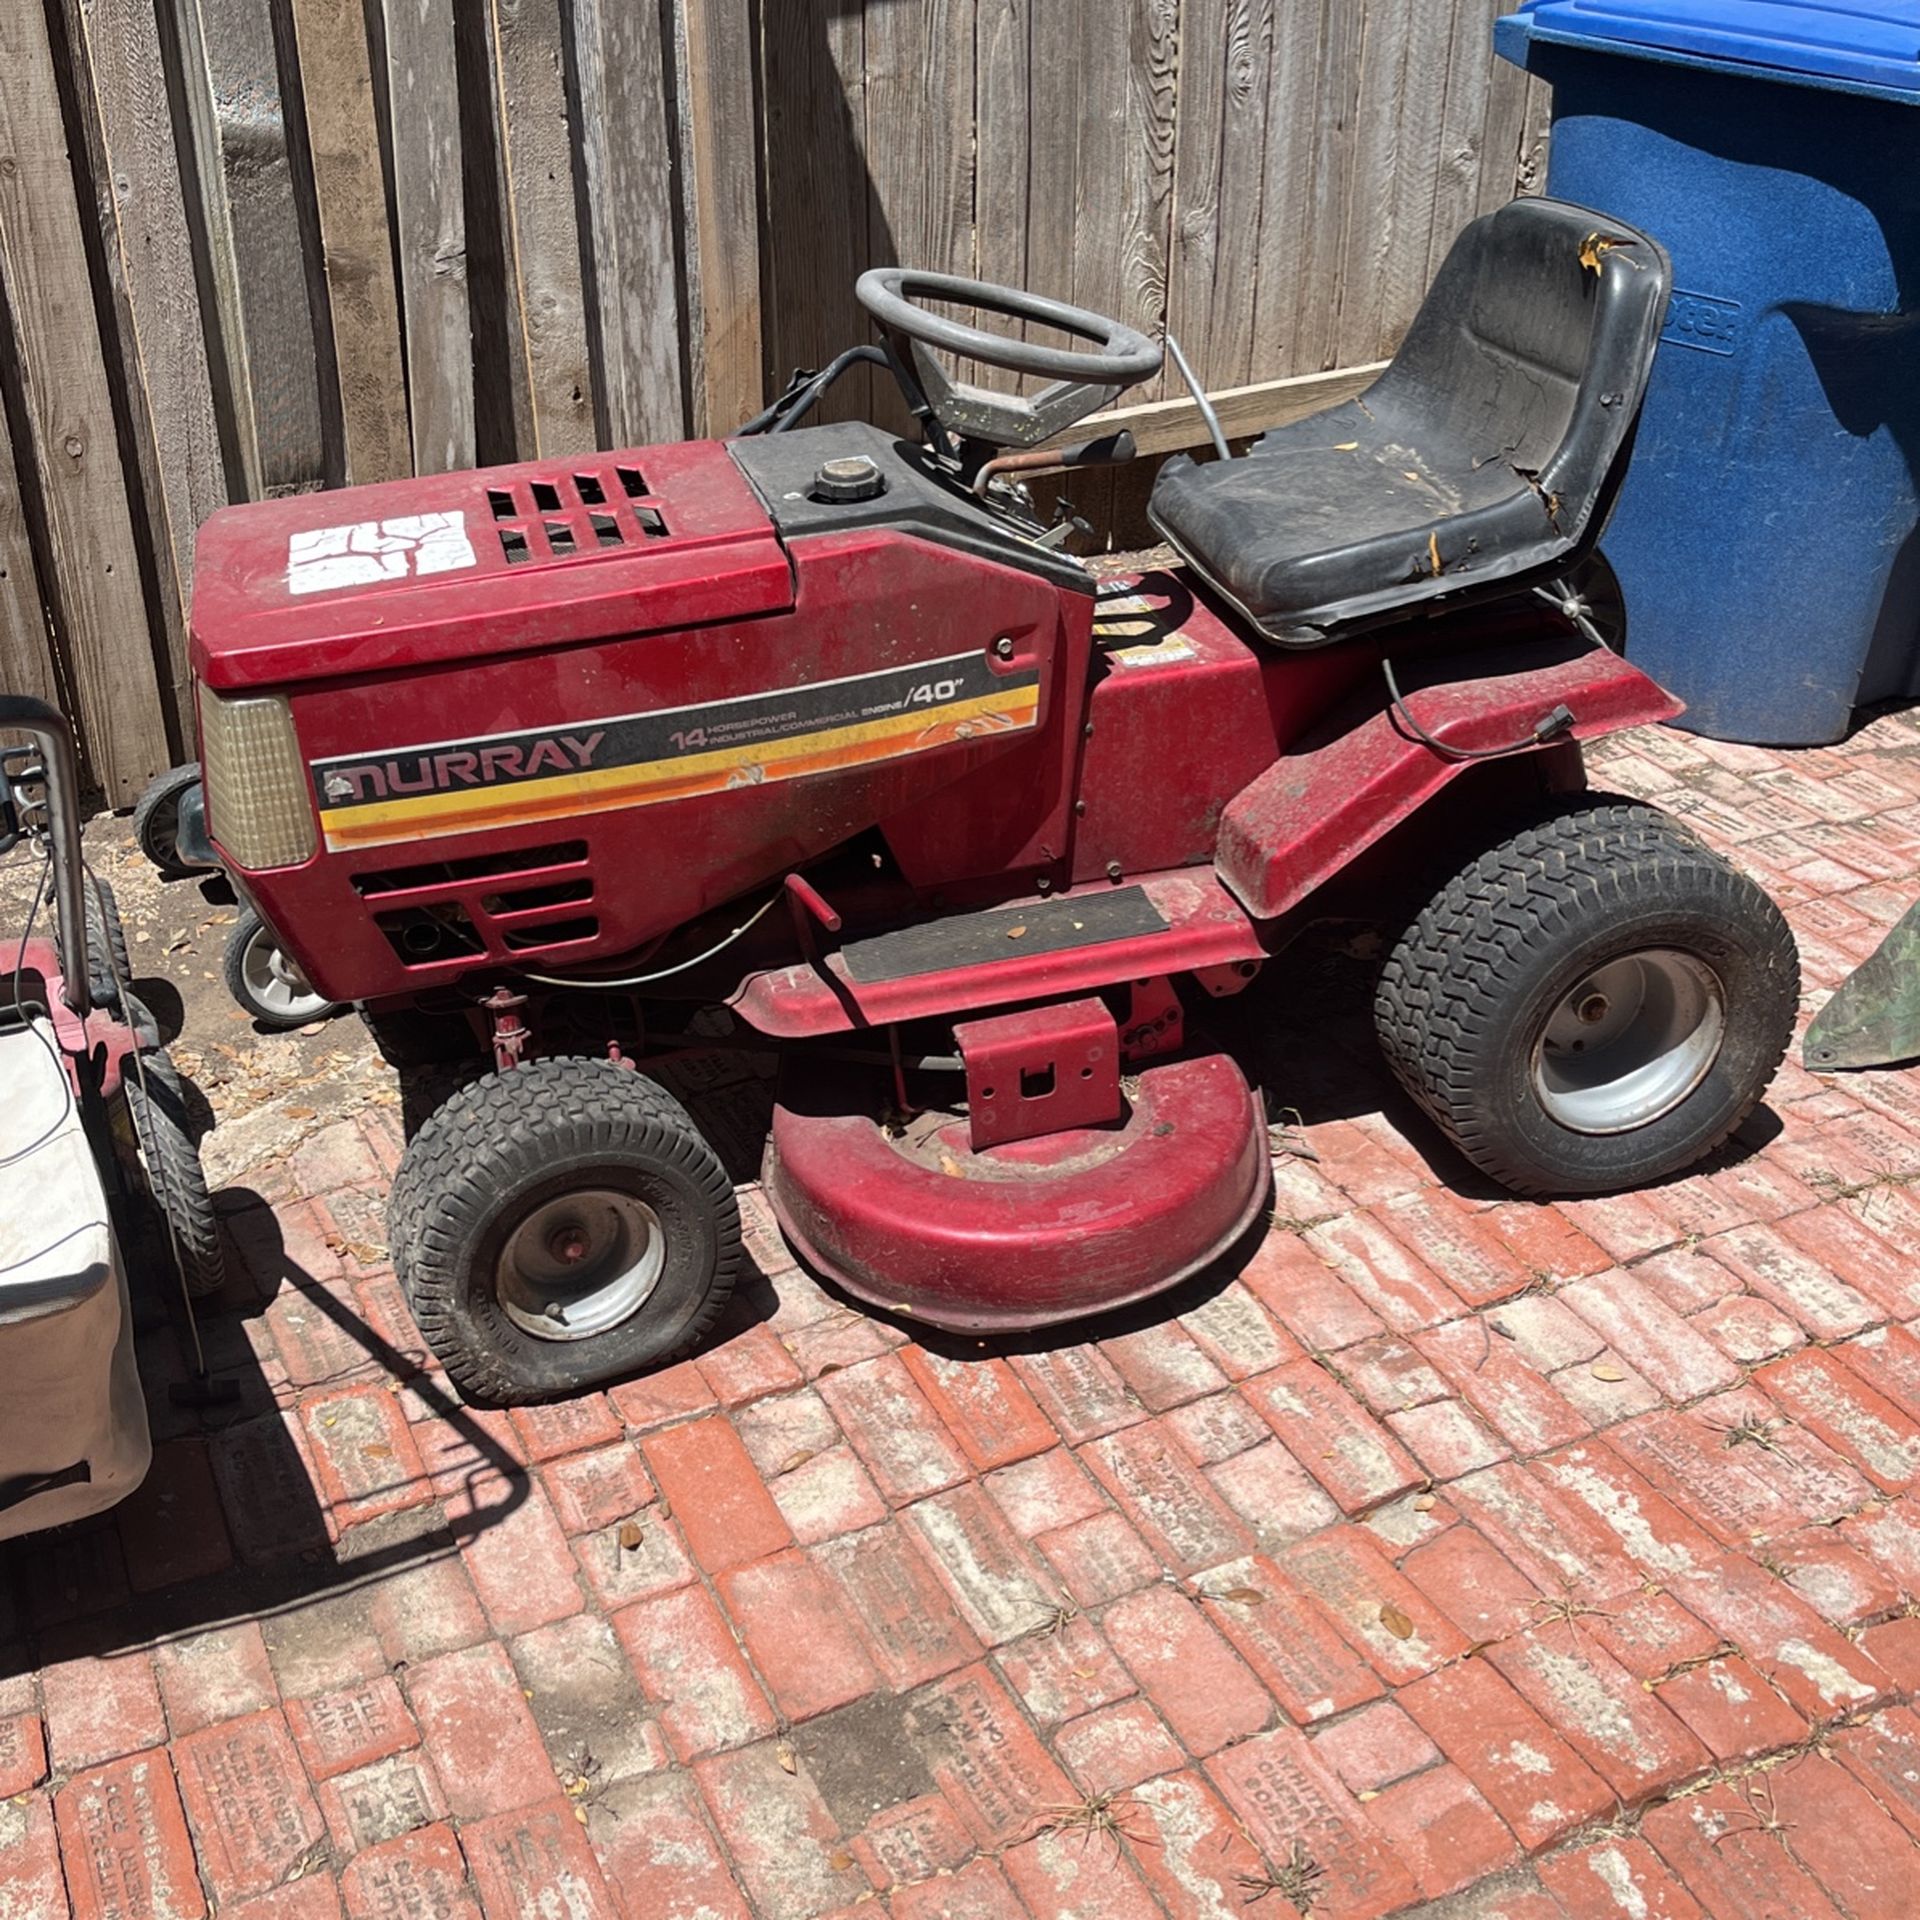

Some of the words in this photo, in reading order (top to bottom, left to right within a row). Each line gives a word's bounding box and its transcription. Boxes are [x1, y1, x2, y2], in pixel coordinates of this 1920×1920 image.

[861, 700, 903, 716] ENGINE
[706, 711, 798, 734] HORSEPOWER
[669, 728, 708, 750] 14
[322, 731, 606, 804] MURRAY
